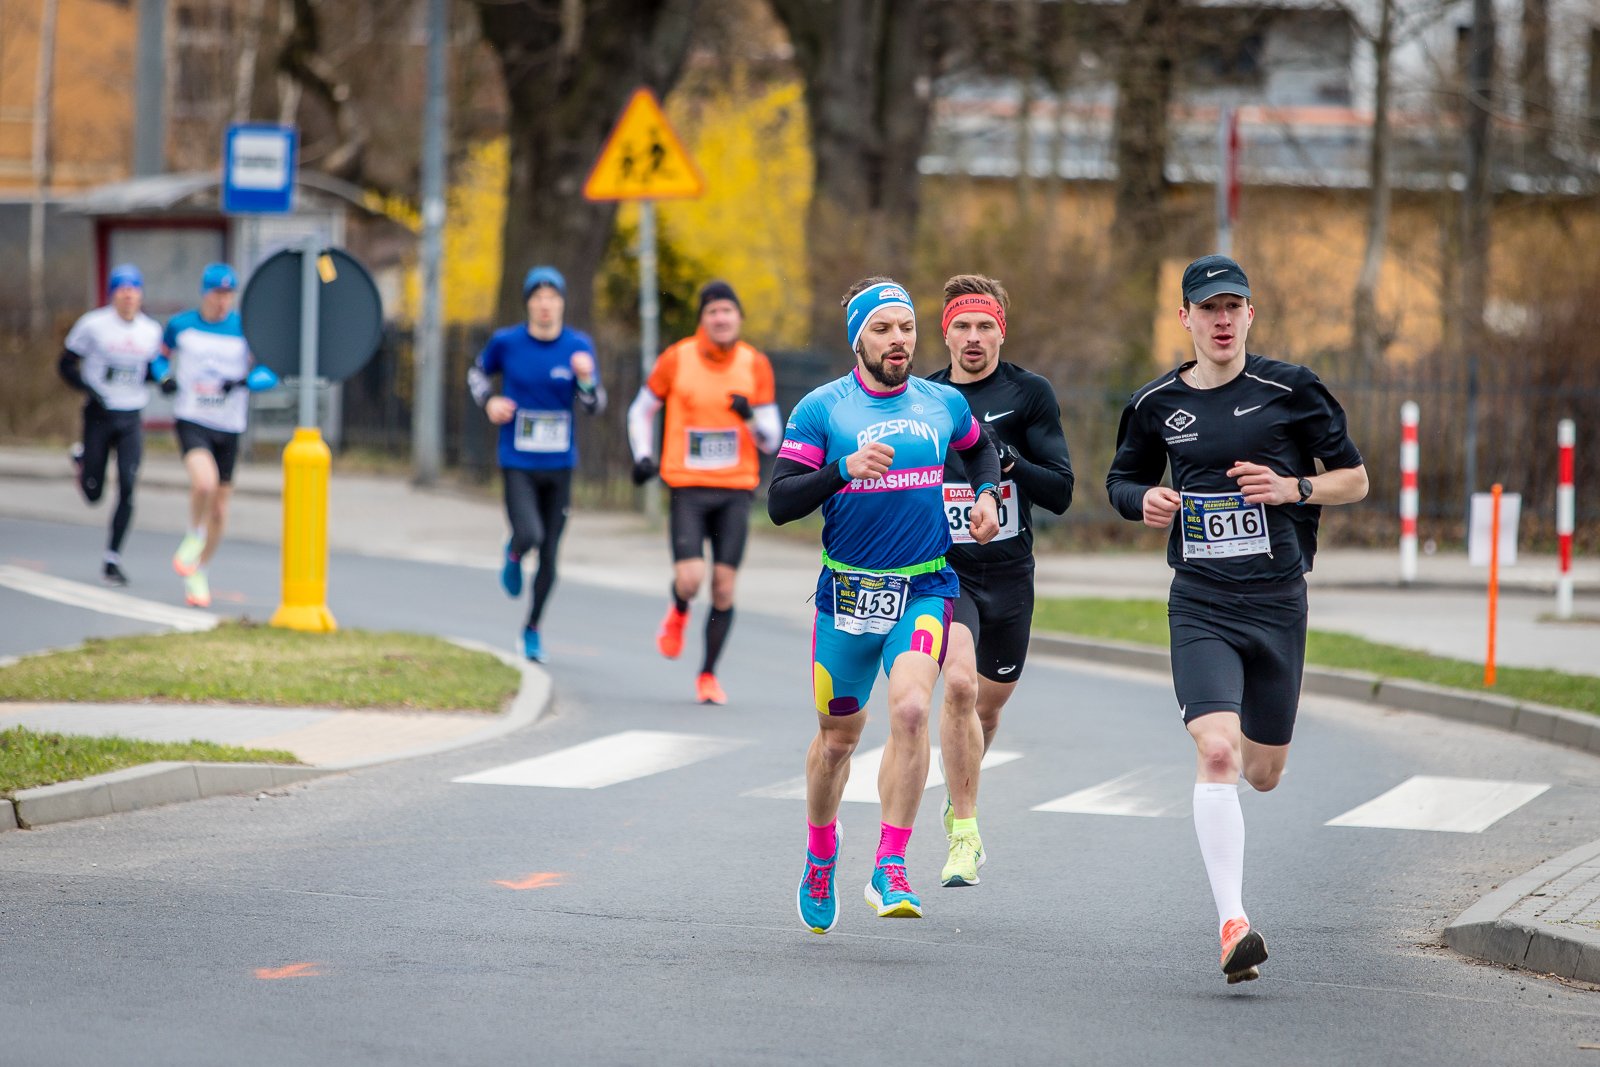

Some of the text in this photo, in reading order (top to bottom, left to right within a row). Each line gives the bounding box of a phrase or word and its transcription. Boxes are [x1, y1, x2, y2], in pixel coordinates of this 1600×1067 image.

[856, 419, 940, 463] BEZSPINY
[850, 469, 941, 490] #DASHRADE
[948, 504, 1008, 530] 390
[1208, 511, 1258, 538] 616
[857, 592, 896, 616] 453
